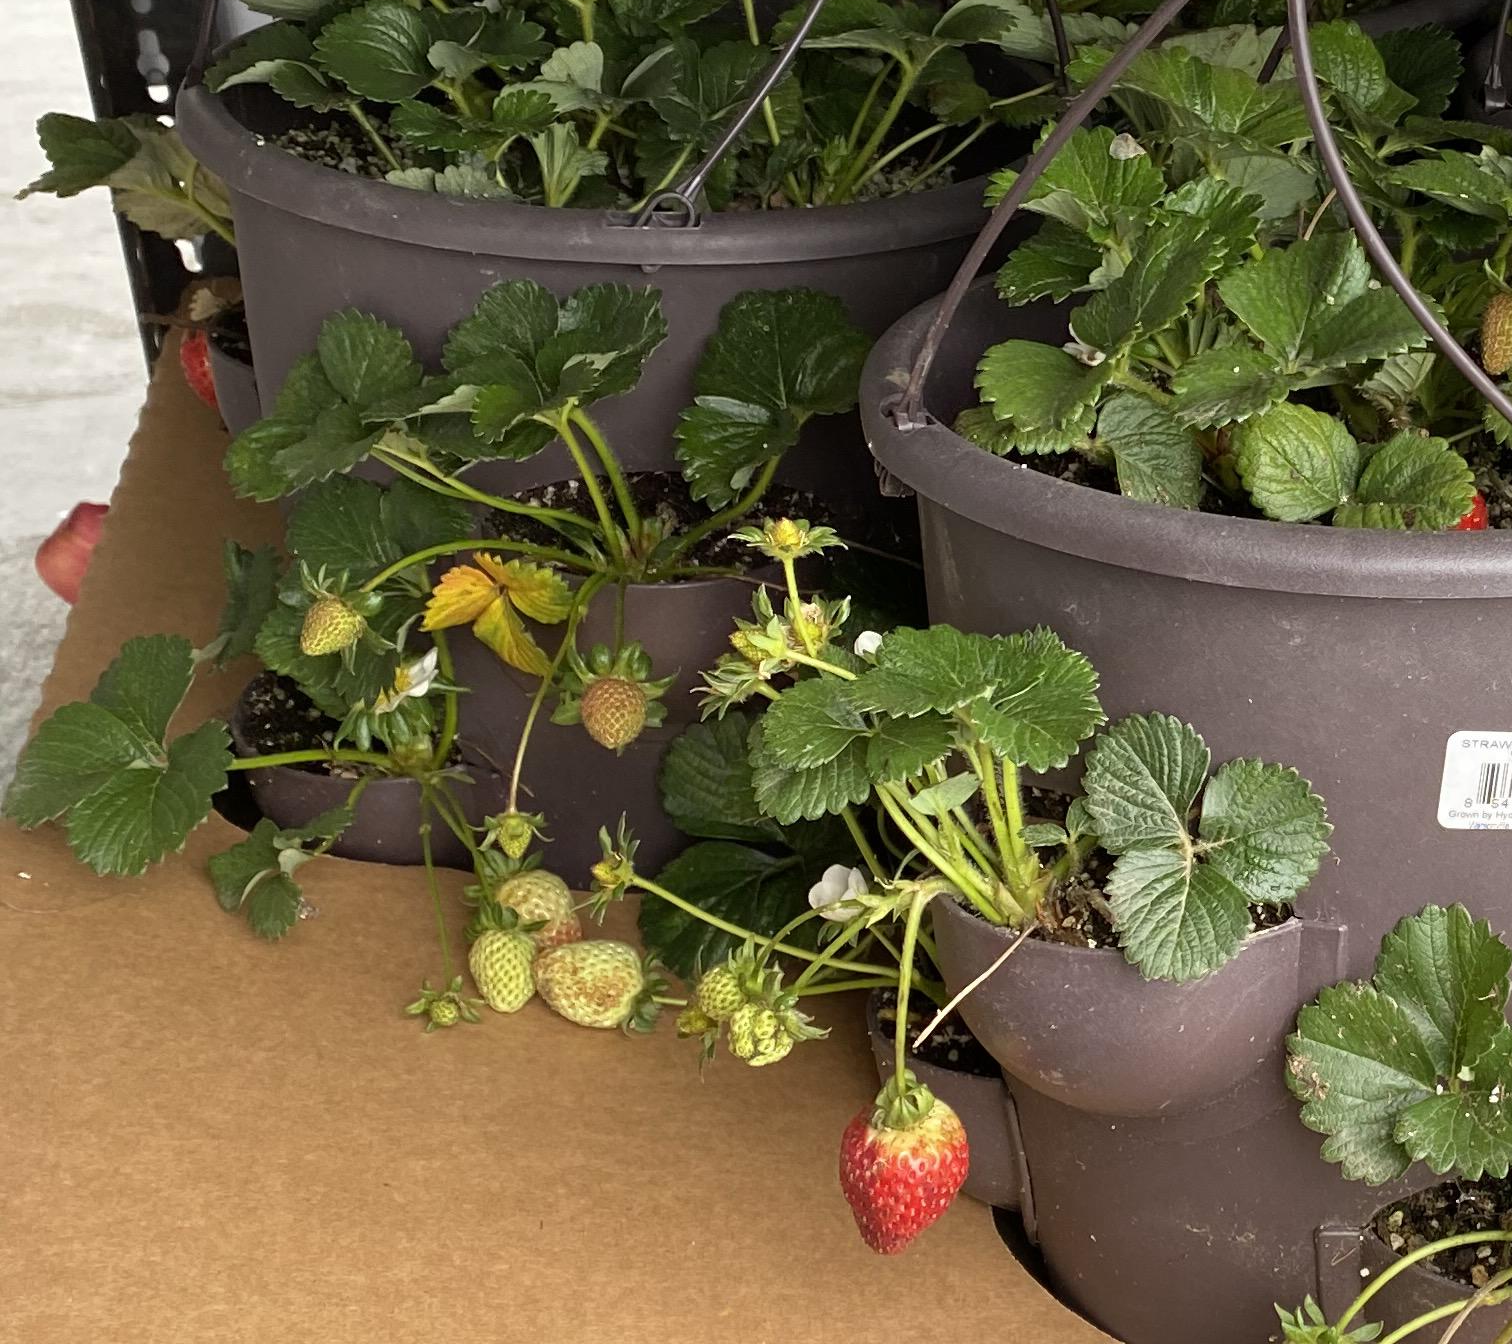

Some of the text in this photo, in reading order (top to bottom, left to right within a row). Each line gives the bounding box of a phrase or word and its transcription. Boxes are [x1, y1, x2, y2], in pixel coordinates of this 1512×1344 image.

[1464, 797, 1474, 808] 8
[1448, 809, 1479, 819] Grown
[1481, 809, 1493, 820] by
